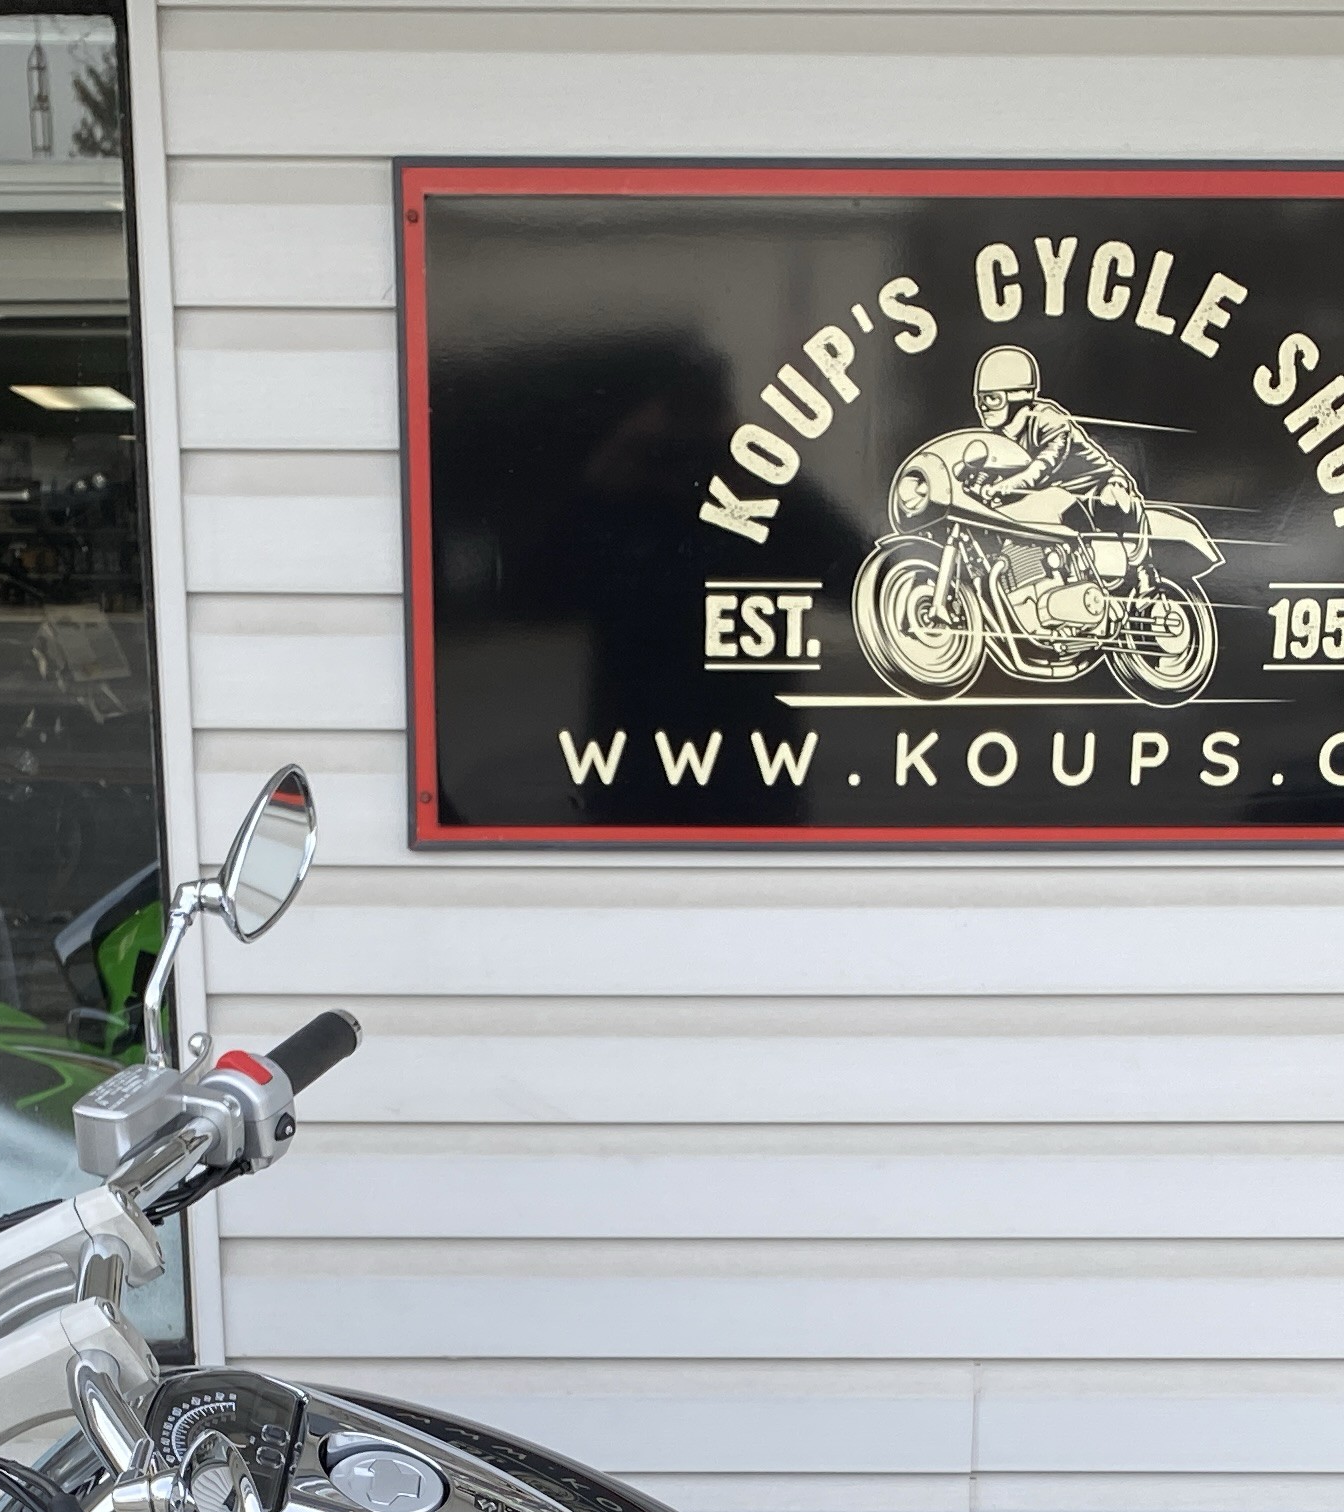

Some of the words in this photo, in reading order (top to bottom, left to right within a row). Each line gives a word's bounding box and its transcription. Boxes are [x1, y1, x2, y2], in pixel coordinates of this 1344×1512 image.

[698, 276, 943, 546] KOUP'S
[974, 235, 1249, 359] CYCLE
[705, 597, 822, 658] EST.
